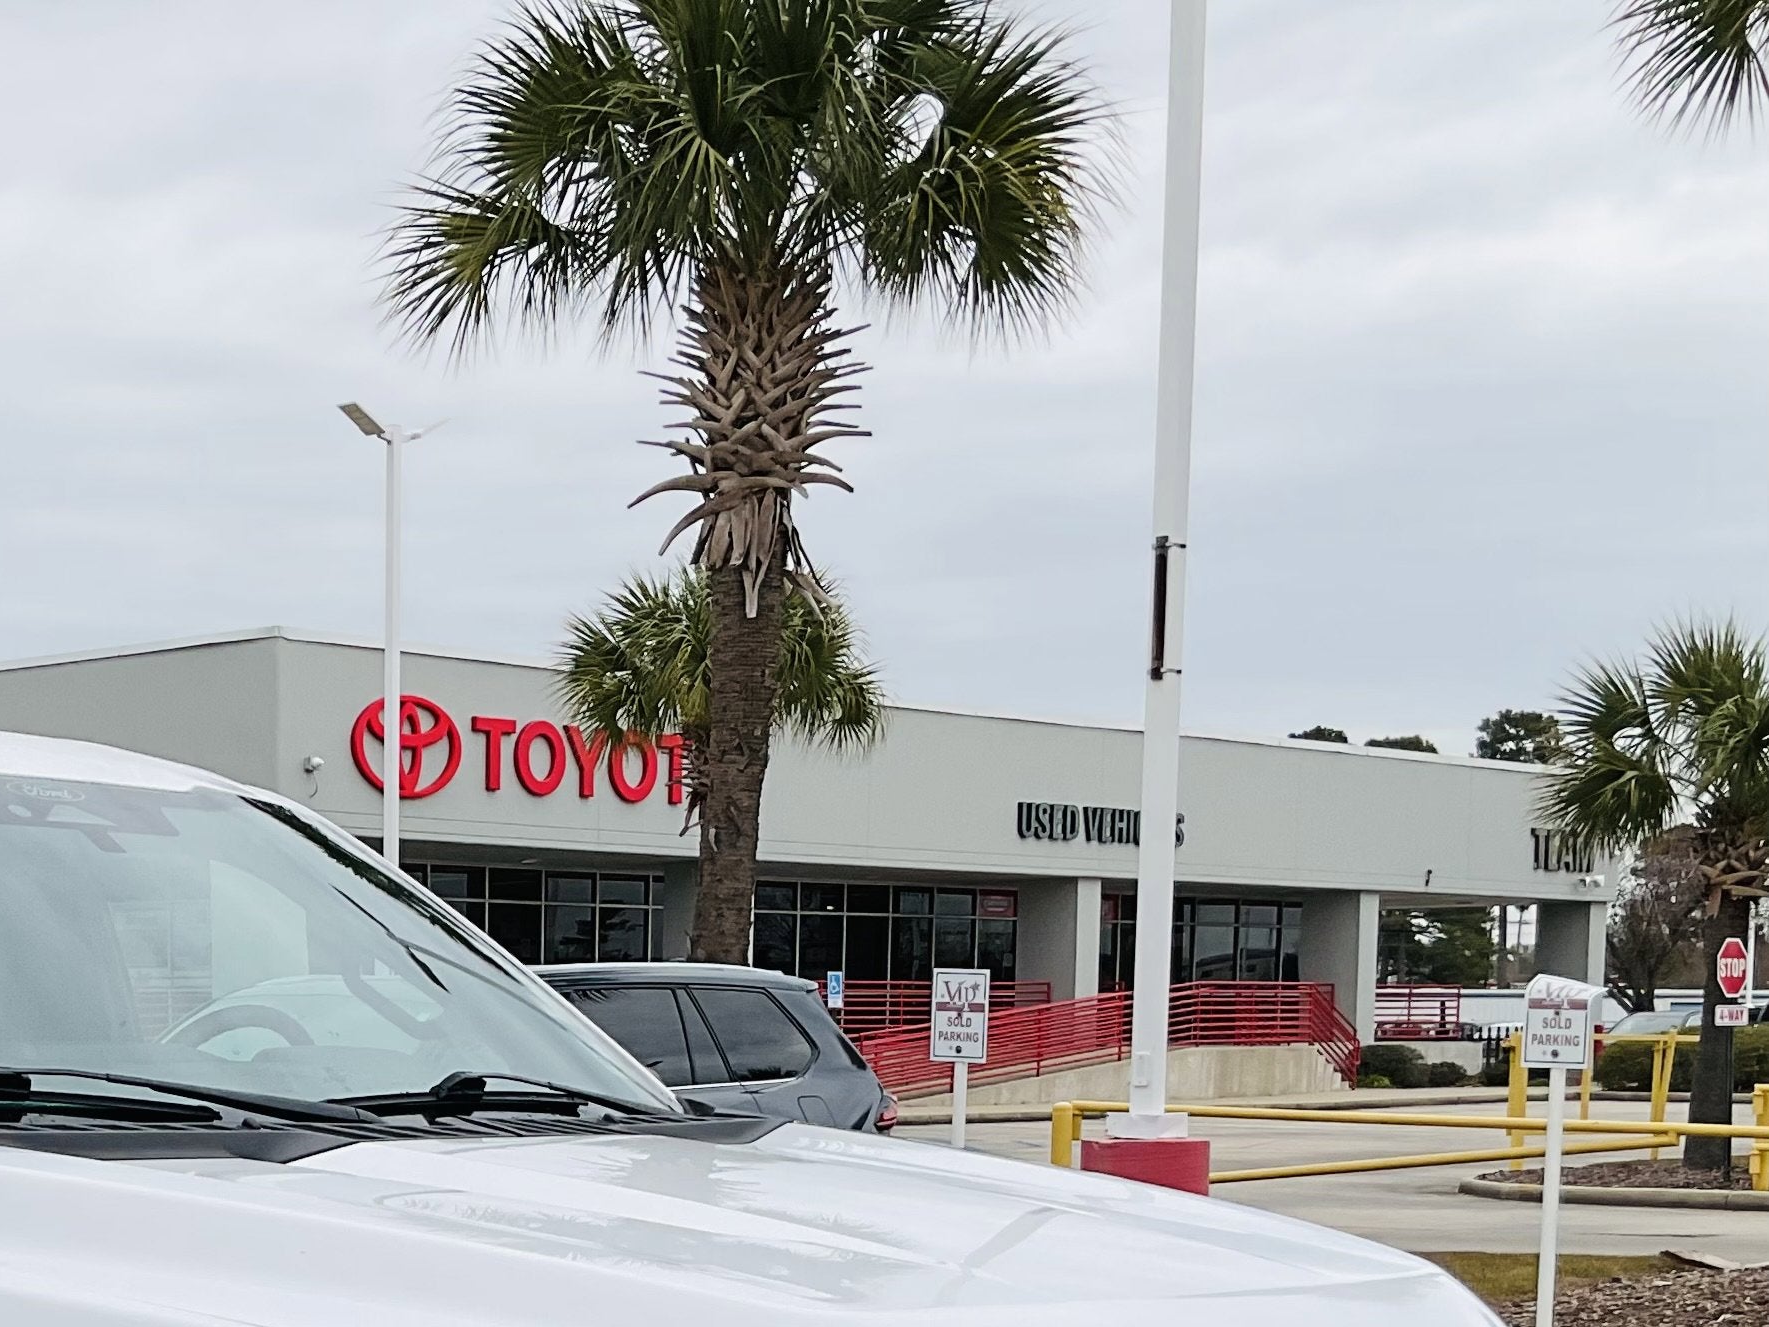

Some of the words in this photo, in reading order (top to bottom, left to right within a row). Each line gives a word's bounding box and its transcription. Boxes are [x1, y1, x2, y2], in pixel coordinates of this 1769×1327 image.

[471, 716, 694, 805] TOYOT
[1017, 801, 1080, 841] USED
[1083, 806, 1185, 849] VEHIS
[1720, 957, 1746, 978] STOP
[1719, 1009, 1744, 1020] 4-WAY
[946, 1016, 972, 1028] SOLD
[1542, 1016, 1572, 1029] SOLD
[938, 1030, 979, 1043] PARKING
[1531, 1033, 1580, 1047] PARKING
